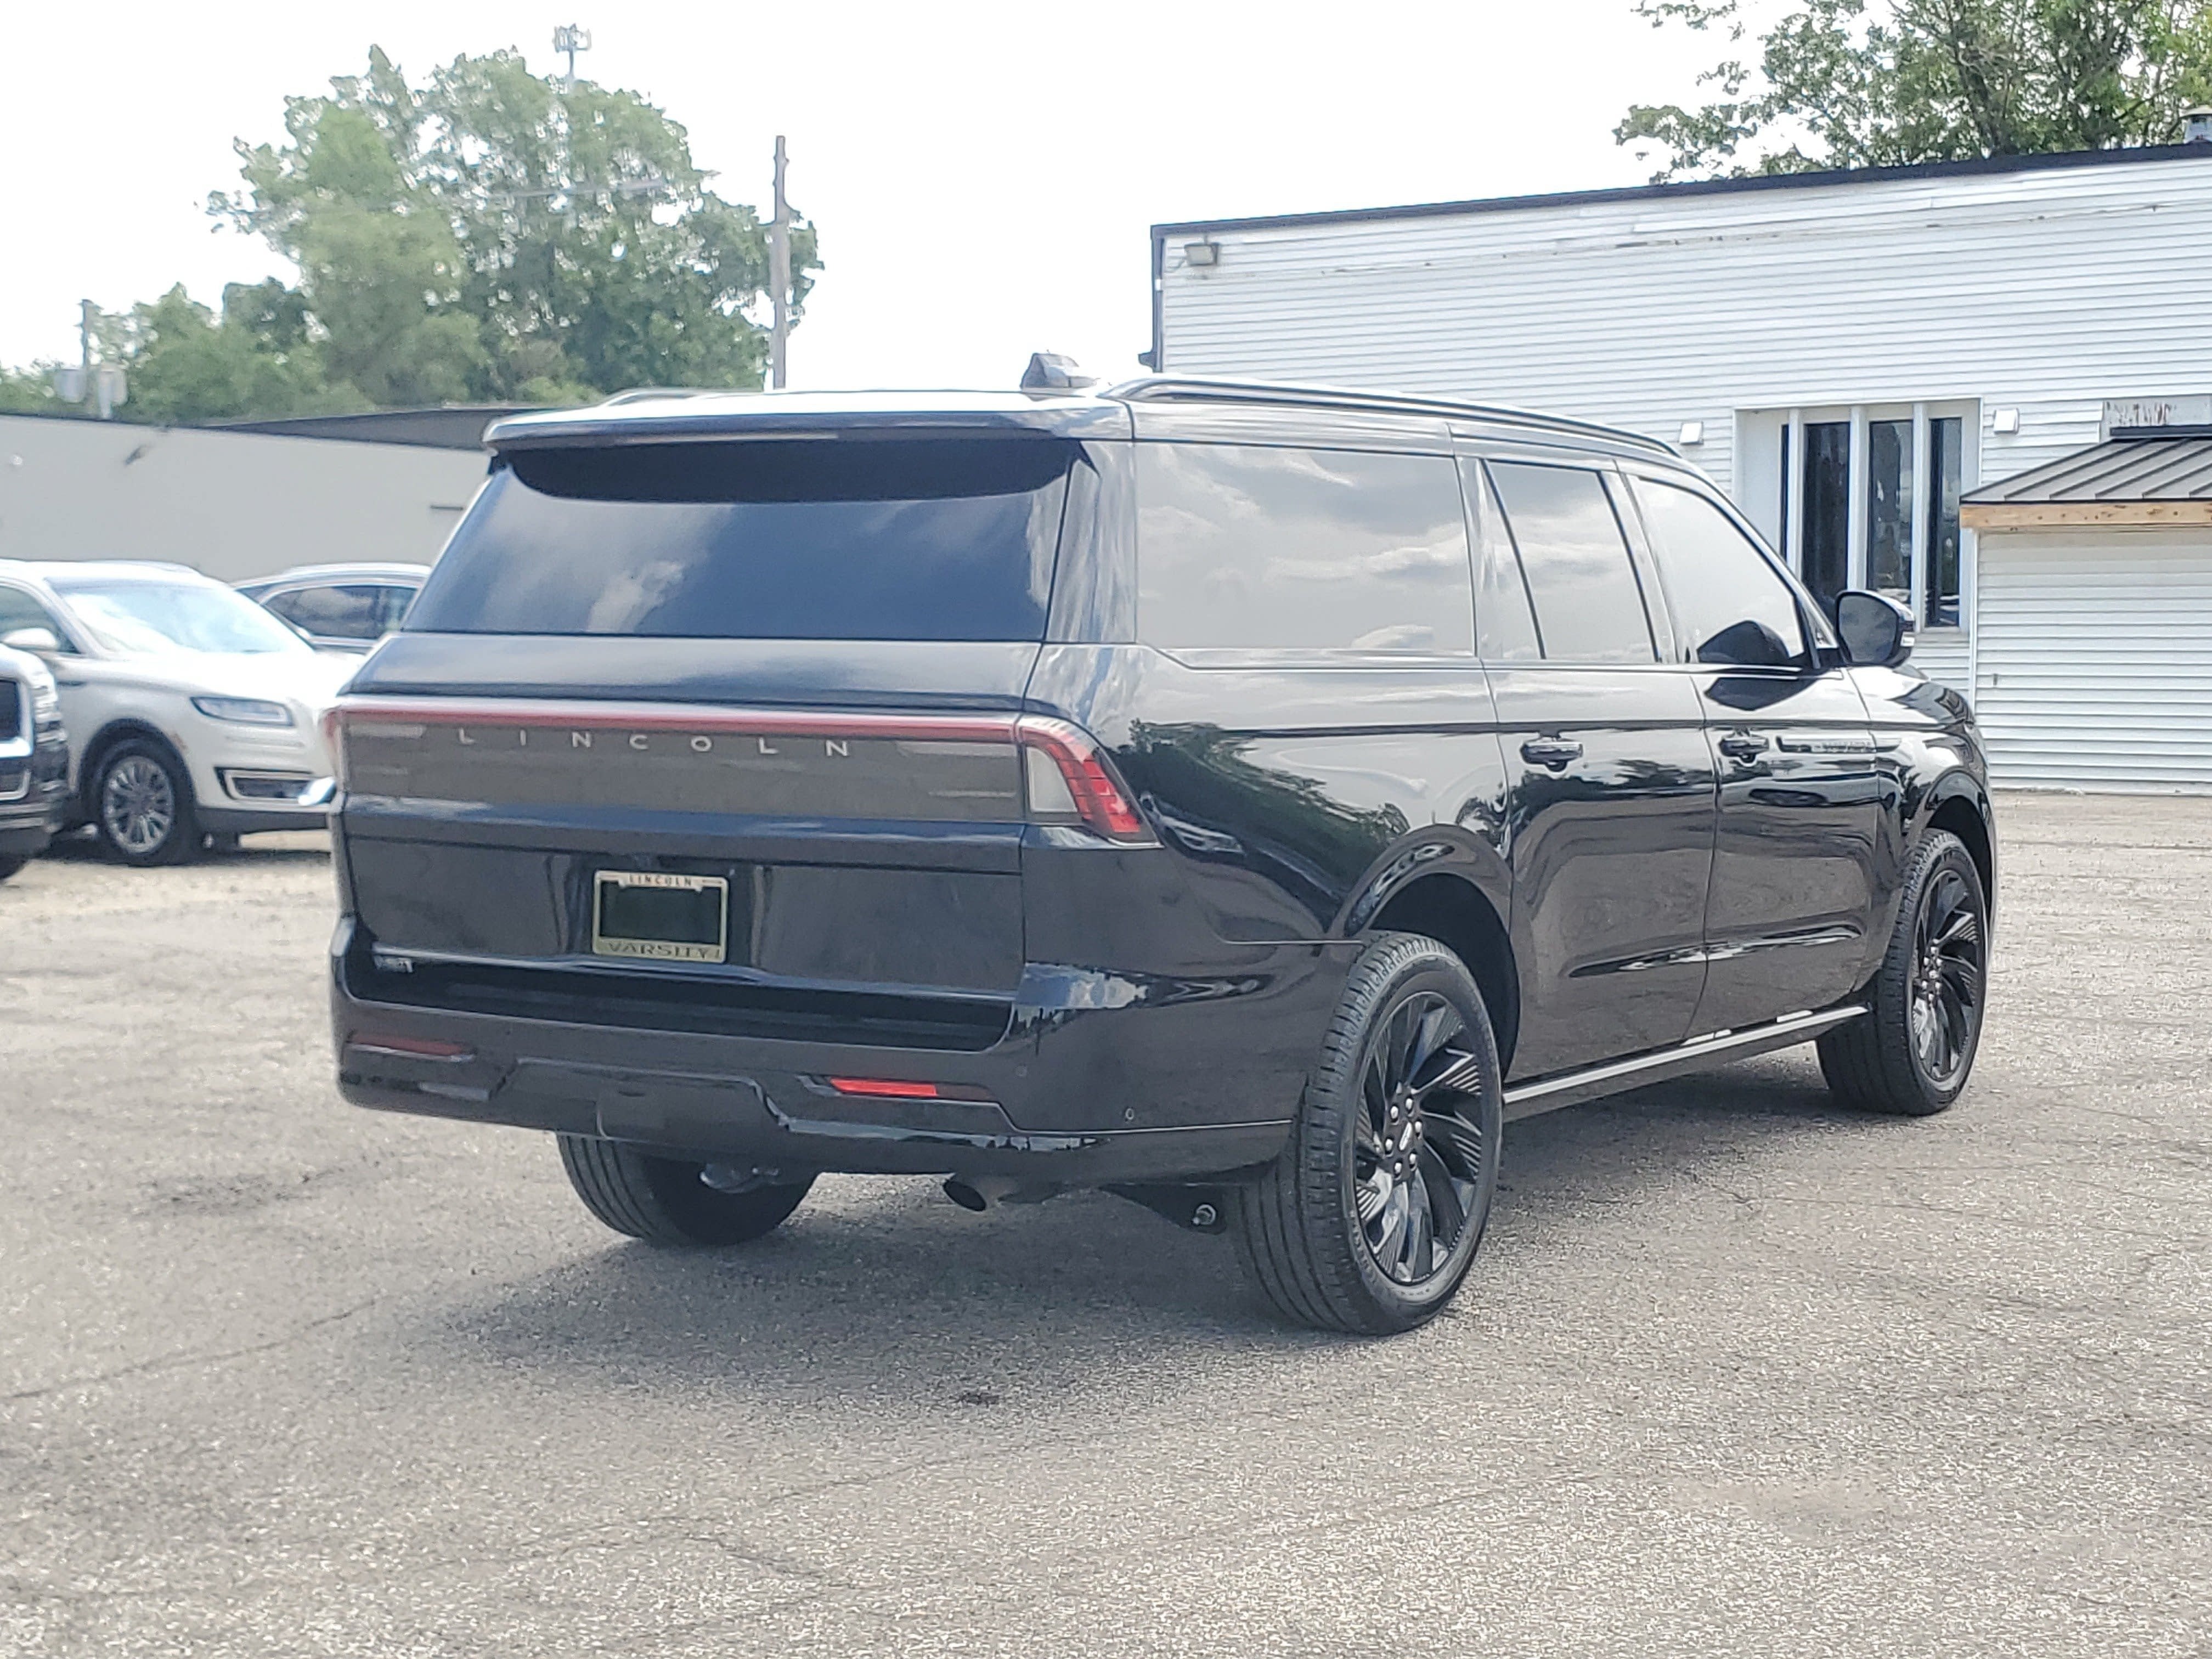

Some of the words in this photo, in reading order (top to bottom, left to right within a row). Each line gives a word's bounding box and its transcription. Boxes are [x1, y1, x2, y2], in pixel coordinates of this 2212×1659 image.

[459, 729, 849, 757] LINCOLN
[629, 875, 692, 887] LINCOLN
[608, 942, 708, 959] VARSITY
